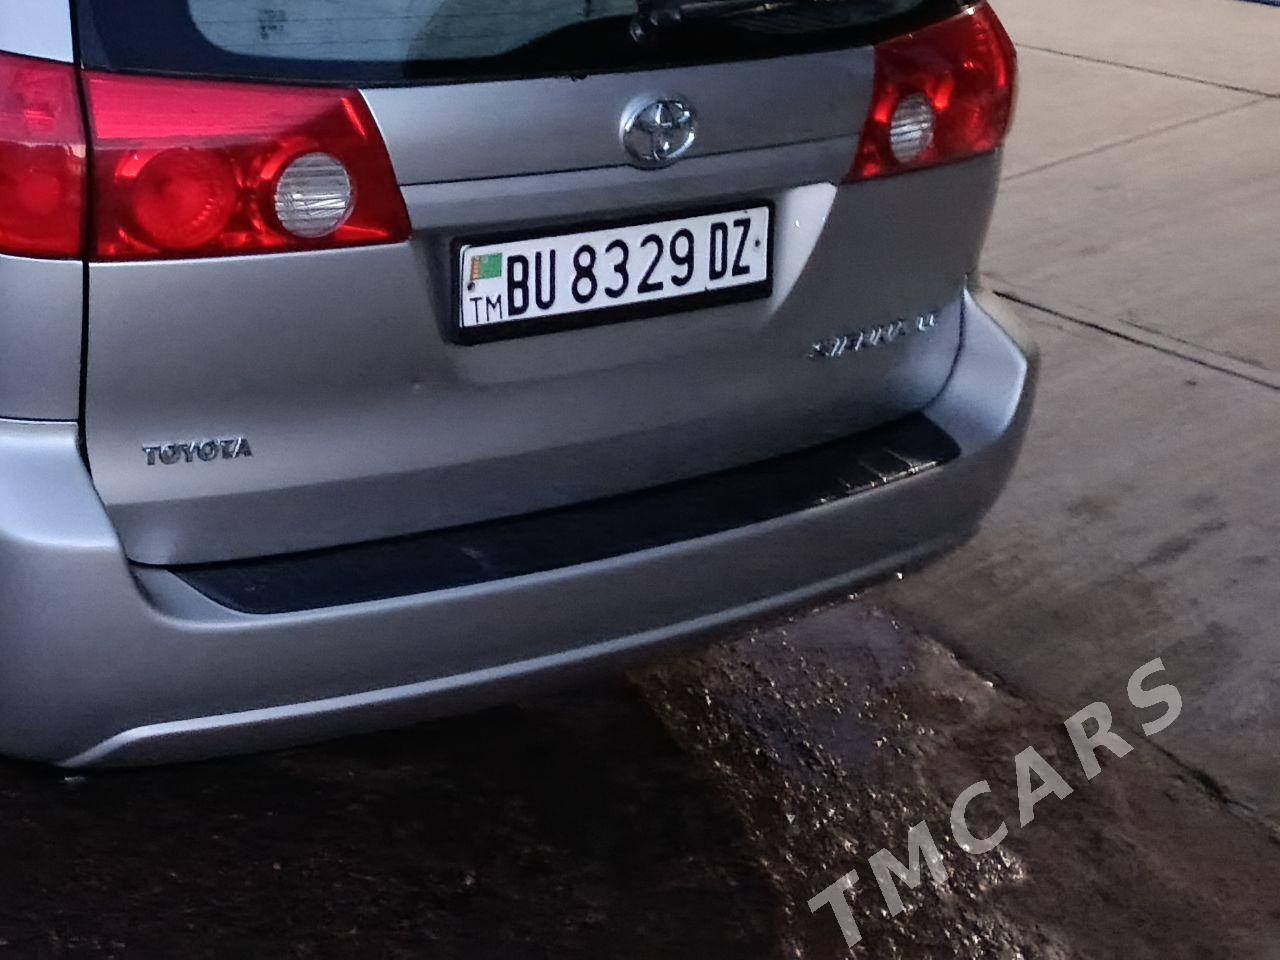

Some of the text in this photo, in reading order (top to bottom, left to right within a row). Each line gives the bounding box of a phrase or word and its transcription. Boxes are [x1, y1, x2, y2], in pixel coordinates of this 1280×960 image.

[507, 218, 751, 316] BU 8329 DZ
[469, 294, 503, 323] TM
[142, 437, 252, 465] TOYOTA
